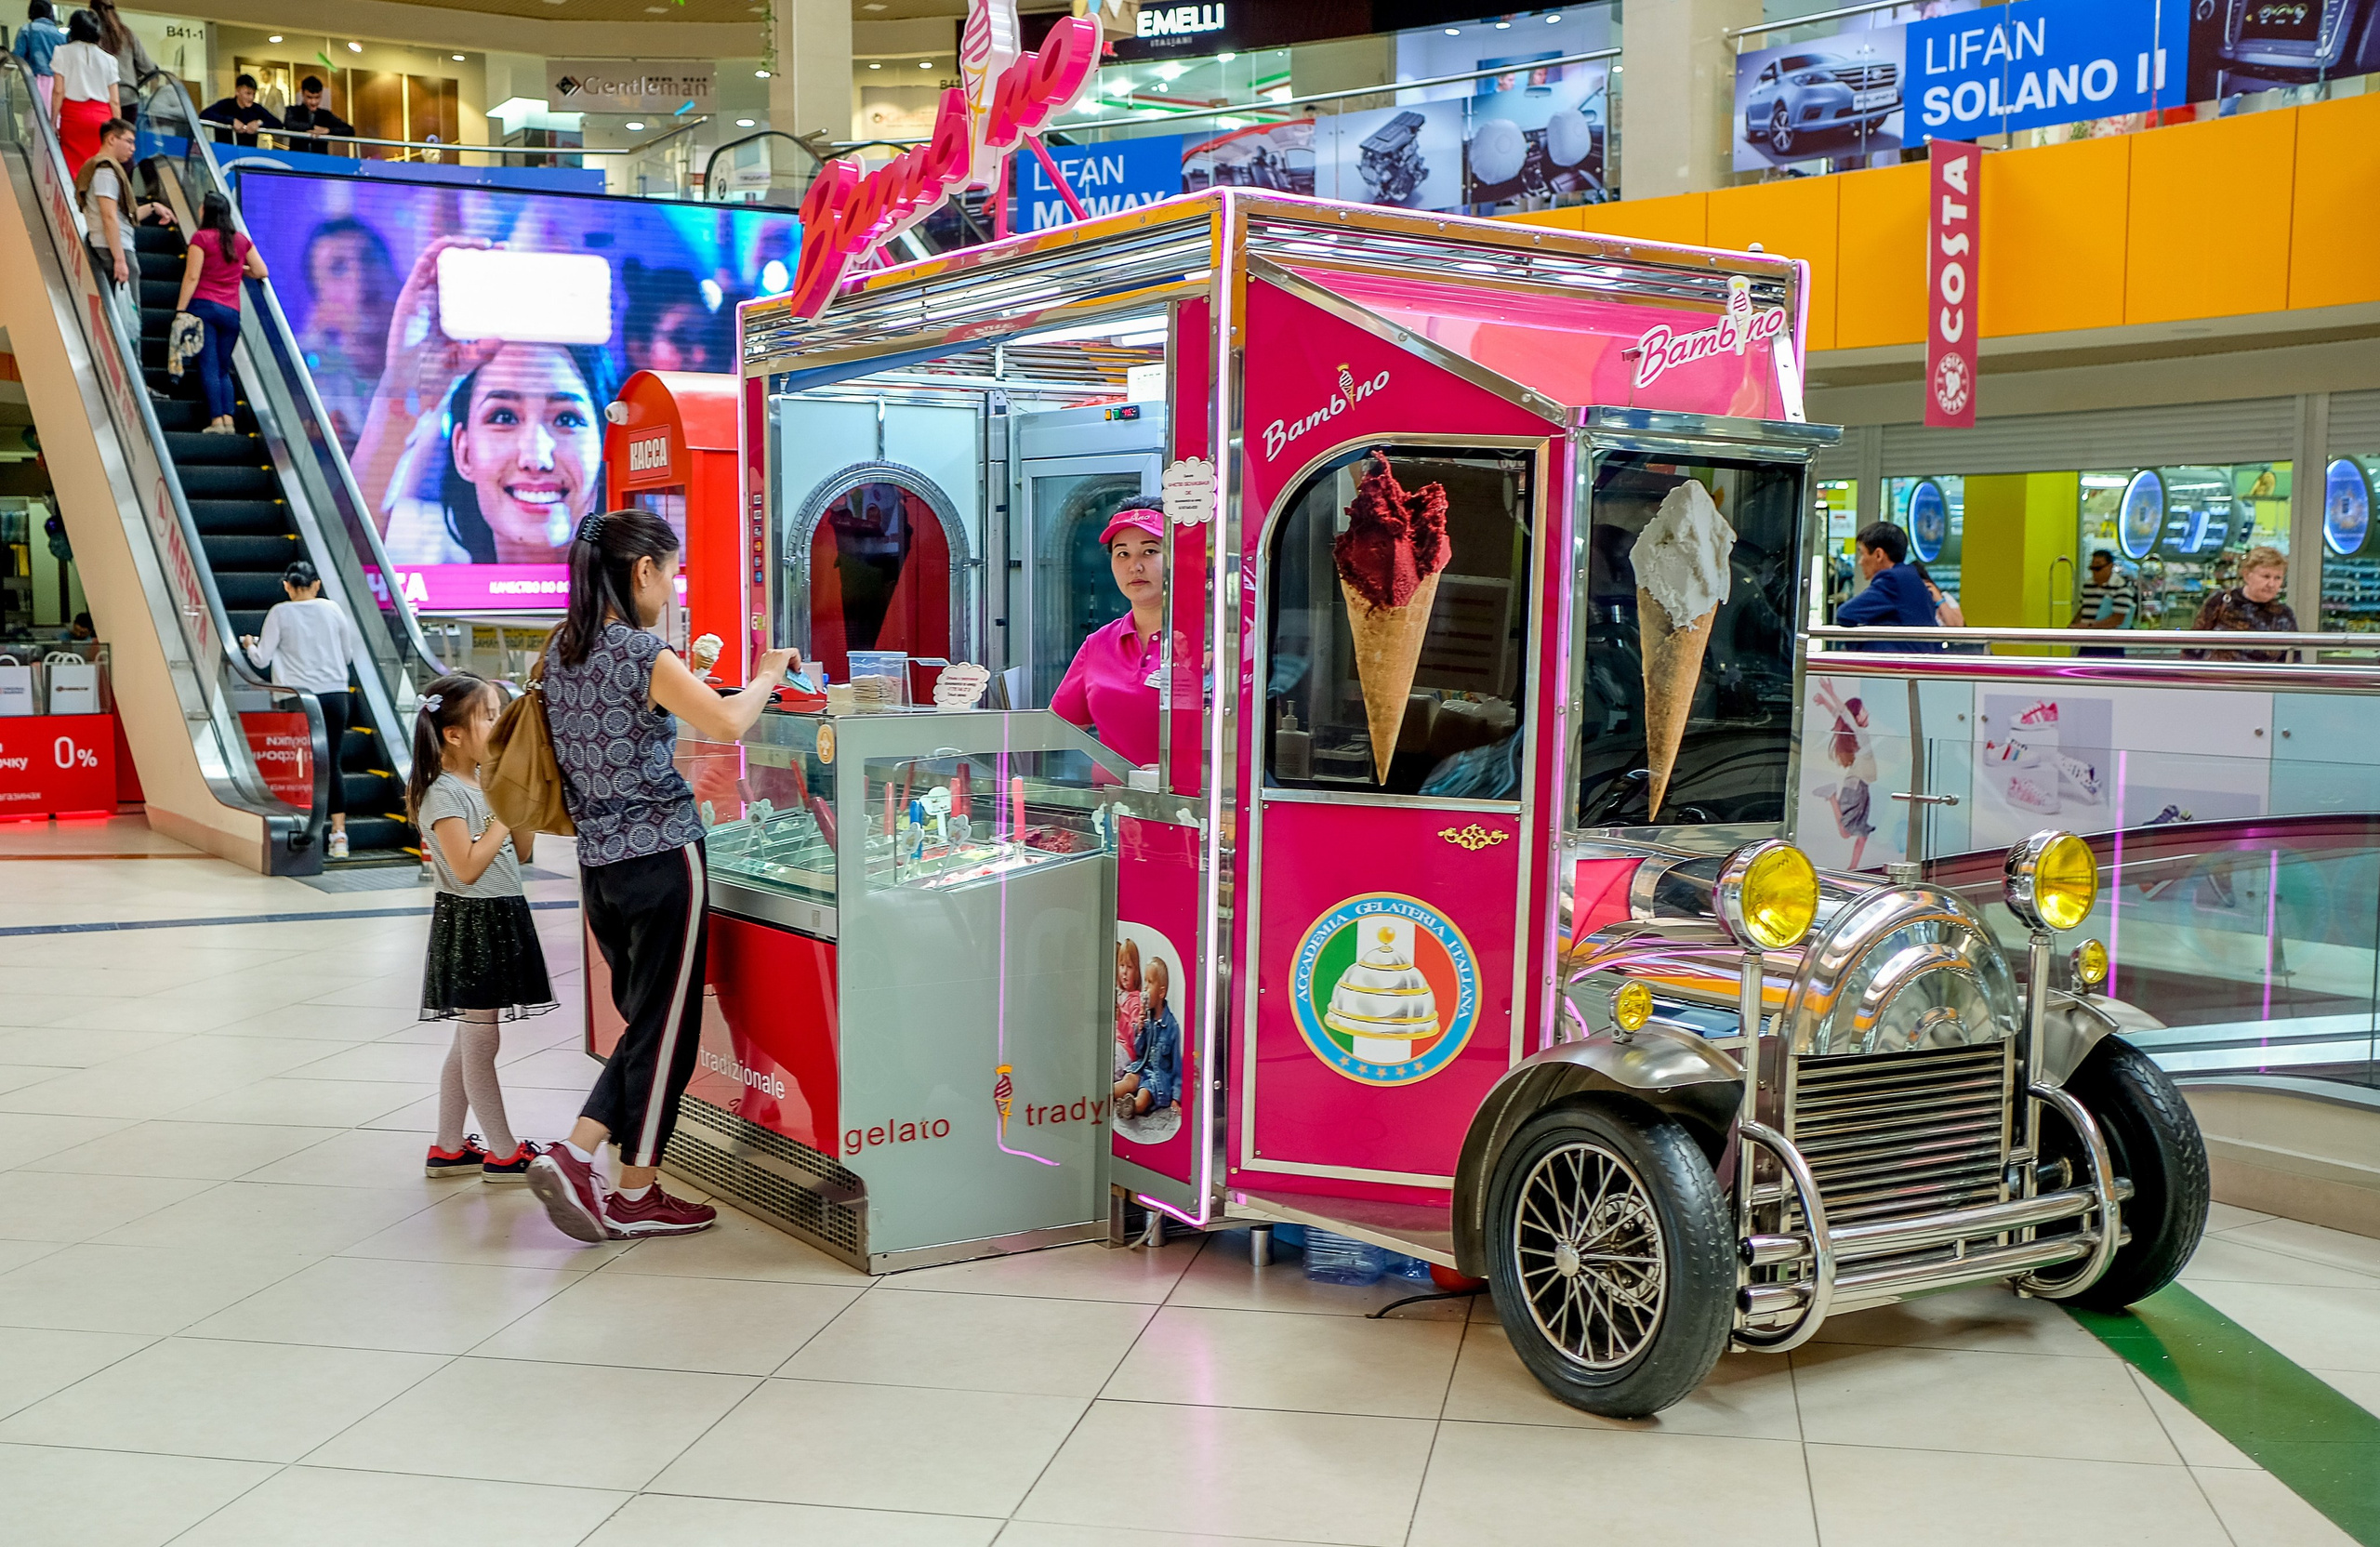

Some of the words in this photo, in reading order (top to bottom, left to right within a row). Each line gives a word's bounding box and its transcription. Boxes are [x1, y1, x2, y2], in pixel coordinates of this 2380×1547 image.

[166, 25, 204, 39] B41-1
[1925, 17, 2045, 75] LIFAN
[583, 75, 708, 97] Gentleman
[1923, 58, 2118, 126] SOLANO
[2136, 48, 2167, 94] II
[1940, 154, 1969, 344] COSTA
[629, 437, 668, 471] КАССА
[54, 735, 98, 769] 0%
[1296, 914, 1349, 1002] ACCADEMIA
[1355, 902, 1446, 937] GELATERIA
[1447, 940, 1473, 1019] ITALIANA
[700, 1045, 786, 1100] tradizionale
[844, 1118, 950, 1156] gelato
